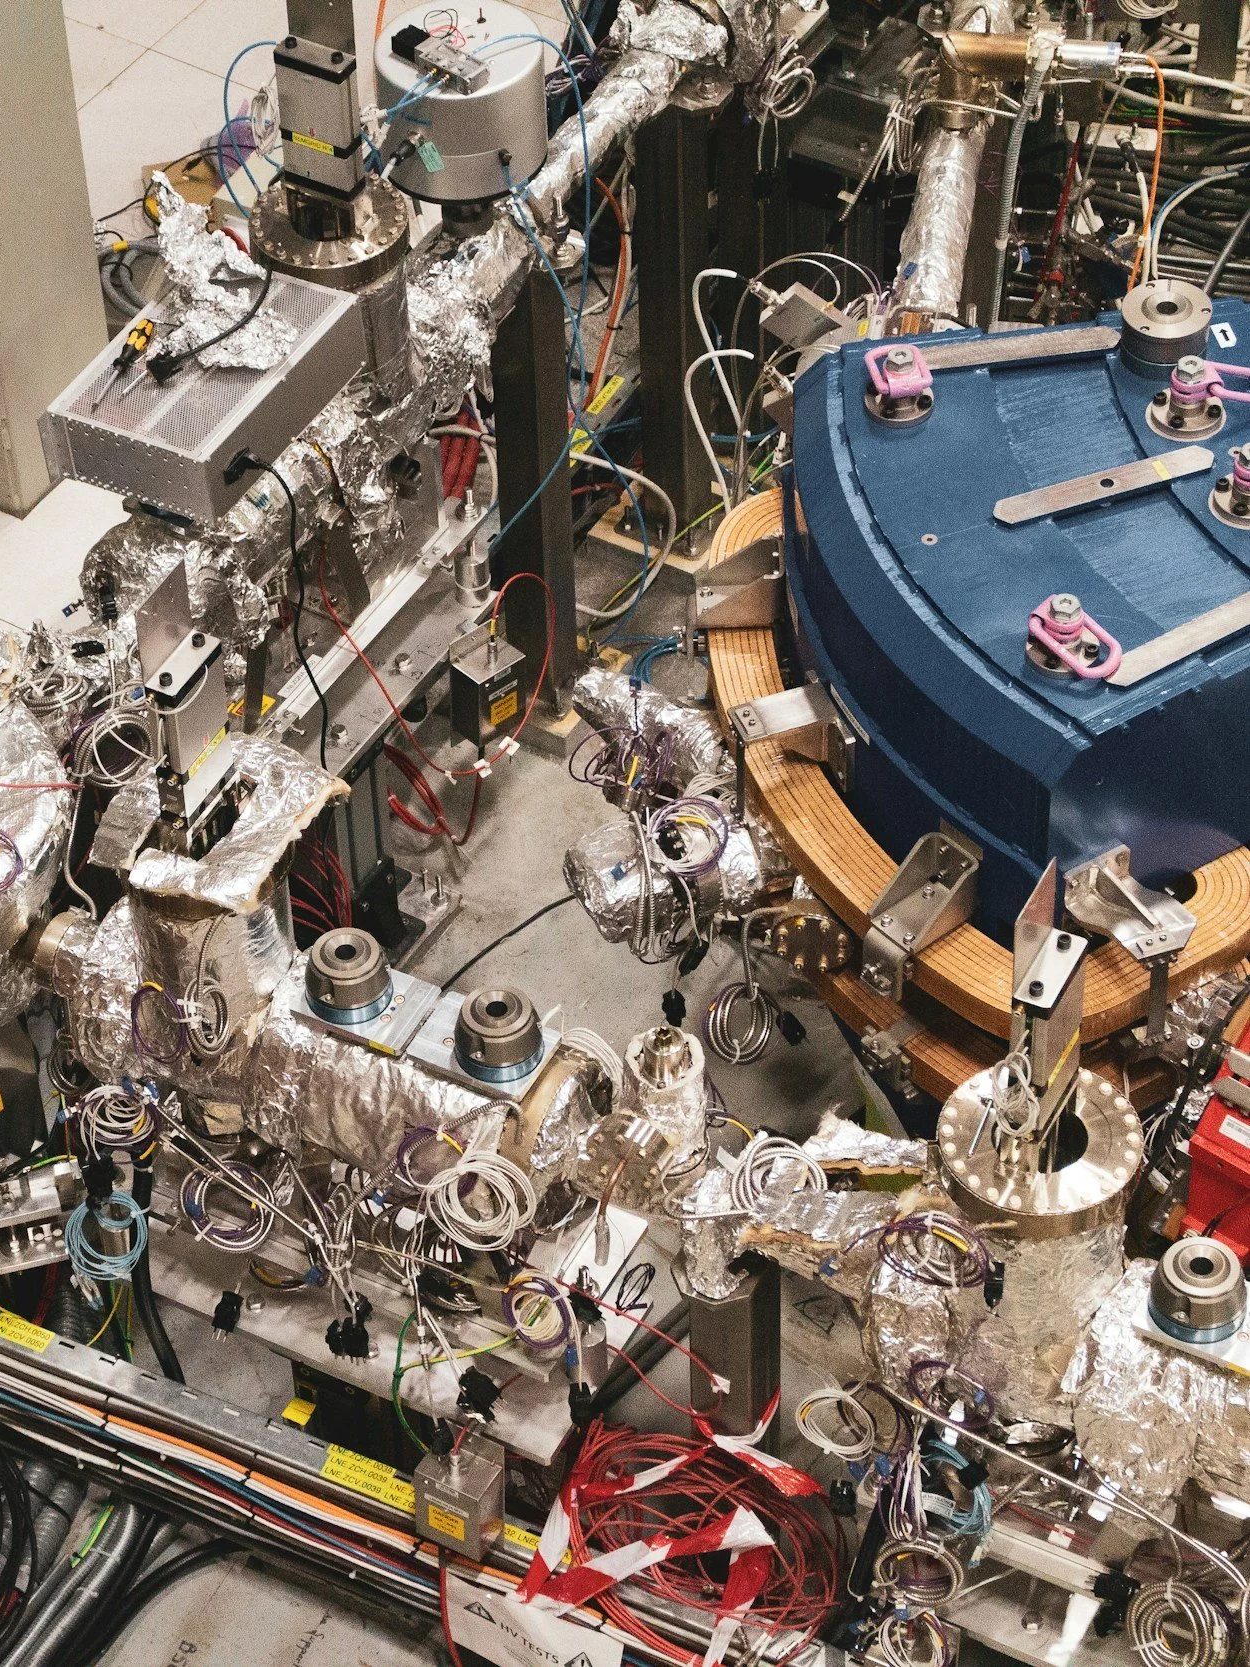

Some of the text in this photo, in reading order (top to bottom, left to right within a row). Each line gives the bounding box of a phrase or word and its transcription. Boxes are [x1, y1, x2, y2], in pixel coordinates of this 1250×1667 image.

[0, 1315, 51, 1341] LNI.ZCH.0050
[324, 1466, 382, 1494] LNE.ZCV.0039
[330, 1456, 388, 1483] LNE.ZCH.0039
[501, 1622, 518, 1638] HV
[521, 1637, 559, 1664] TESTS
